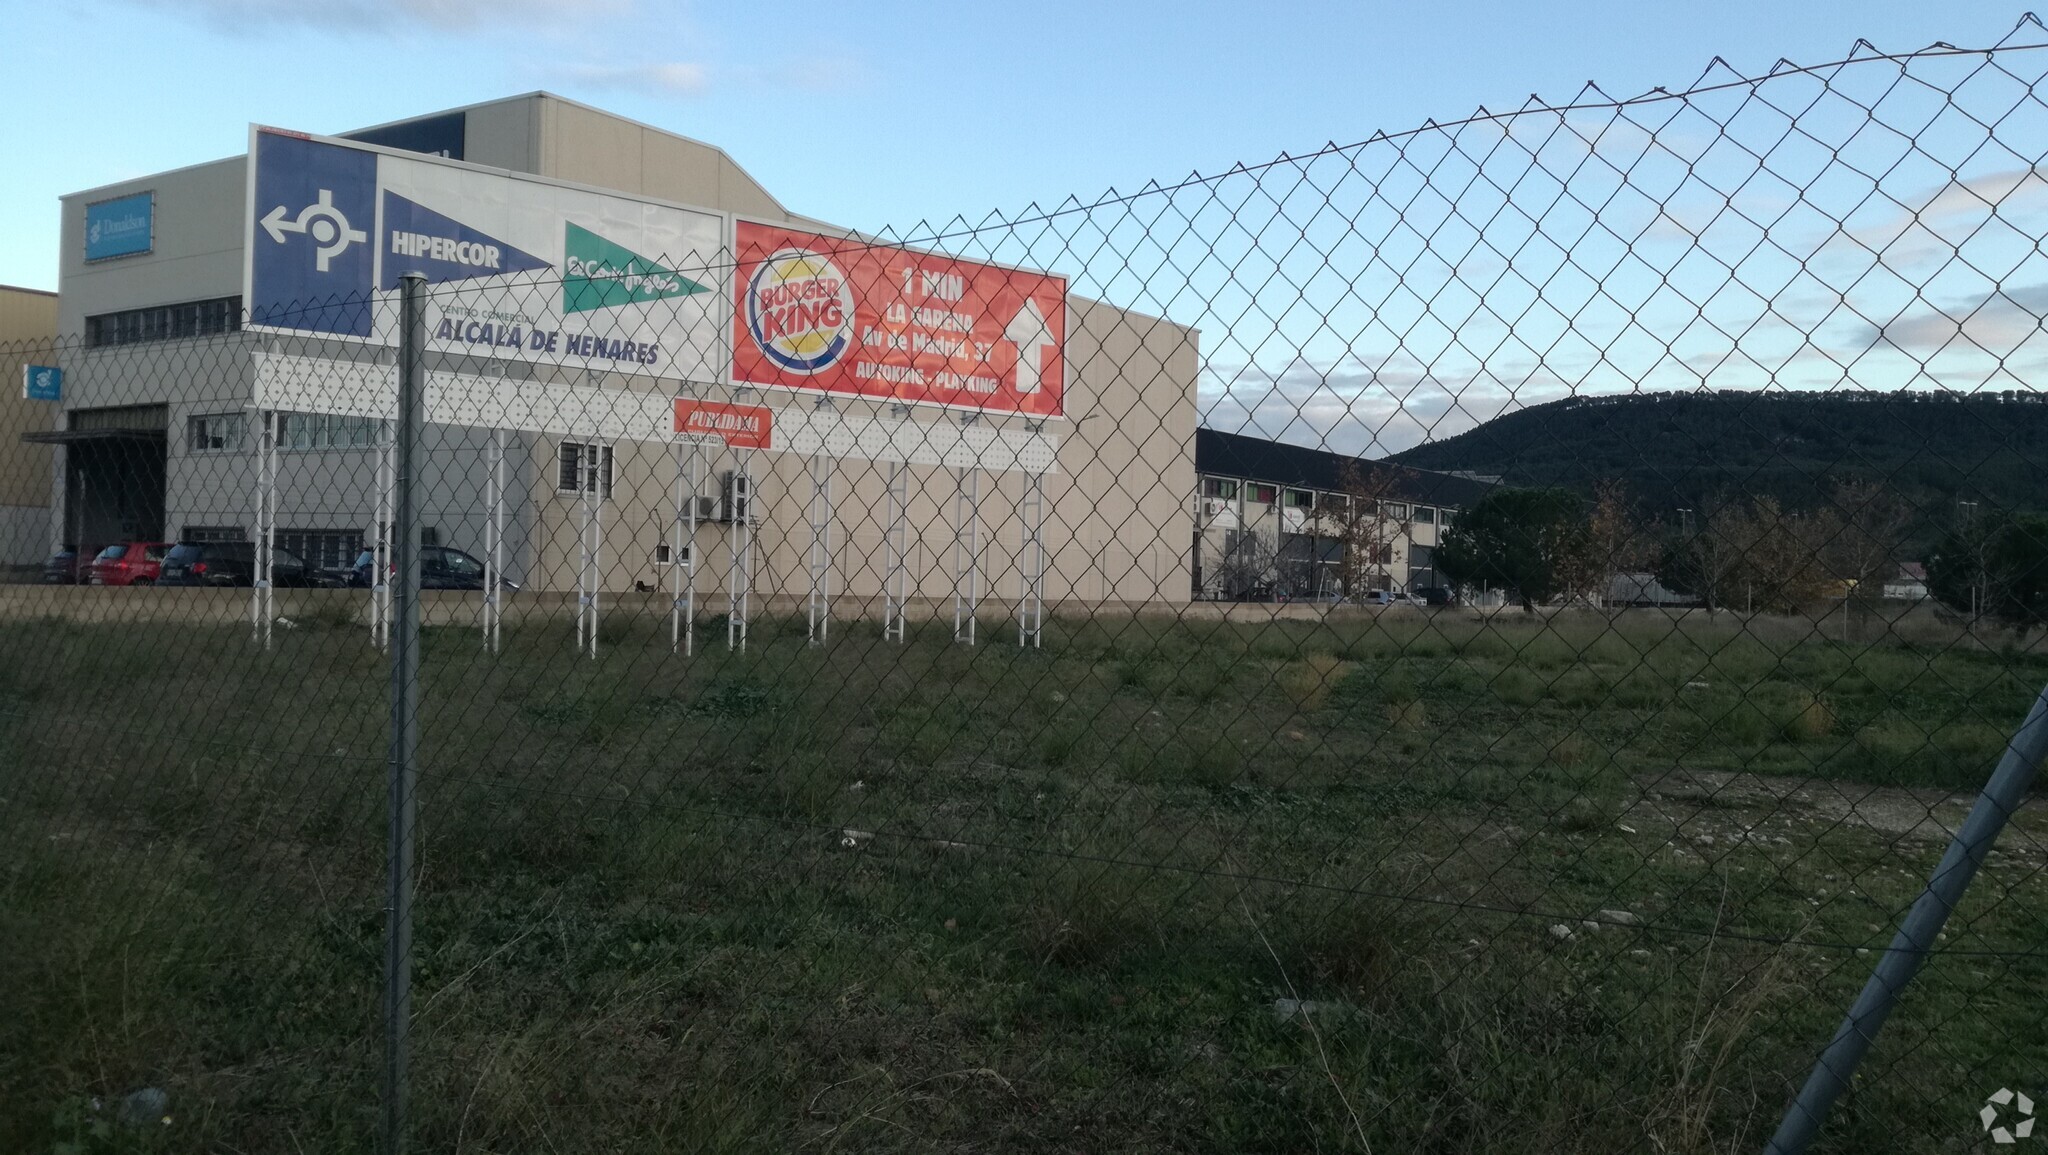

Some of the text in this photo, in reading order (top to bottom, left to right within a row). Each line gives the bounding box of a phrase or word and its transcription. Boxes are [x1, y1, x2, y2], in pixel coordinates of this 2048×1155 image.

[392, 230, 500, 269] HIPERCOR
[760, 278, 840, 311] BURGER
[902, 267, 964, 302] 1 MIN
[441, 304, 535, 325] CENTRO COMERCIAL
[763, 299, 843, 342] KING
[886, 302, 974, 334] LA GARENA
[435, 317, 659, 365] ALCALÁ DE HENARES
[862, 325, 993, 362] Av de Madrid, 37
[855, 361, 924, 385] AUTOKING
[935, 371, 998, 395] PLAYKING
